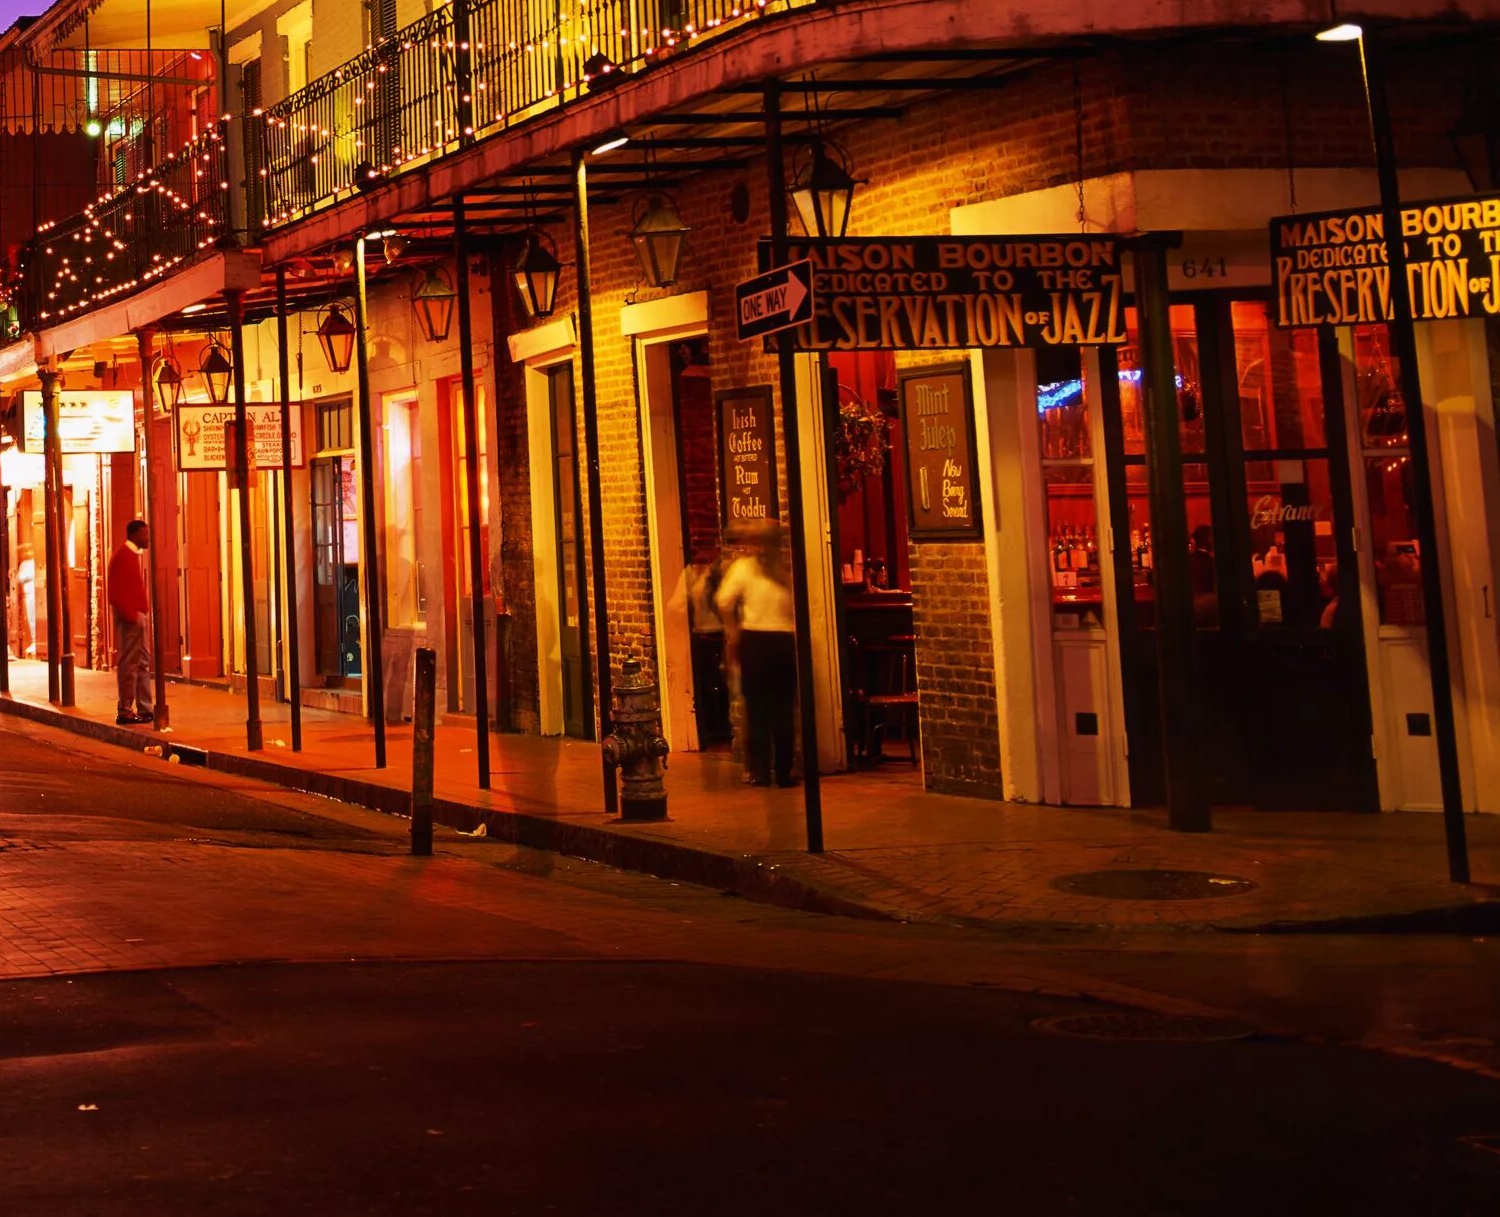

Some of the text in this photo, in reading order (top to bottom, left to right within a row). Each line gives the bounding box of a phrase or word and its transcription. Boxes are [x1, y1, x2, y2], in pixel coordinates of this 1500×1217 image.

[1281, 213, 1384, 248] MAISON
[938, 241, 1115, 269] BOURBON
[1296, 240, 1409, 269] DEDICATE
[1427, 233, 1462, 258] TO
[1182, 256, 1227, 279] 641
[813, 269, 1094, 293] EDICATED TO THE
[1276, 257, 1470, 326] PRESERVTION
[1469, 277, 1491, 294] OF
[743, 286, 787, 321] ONE WAY
[768, 274, 1127, 351] ESERVATION OF JAZZ
[916, 383, 950, 416] Mint
[202, 410, 282, 423] CAPTN AL'
[732, 407, 757, 429] Irish
[728, 431, 762, 453] Coffee
[919, 418, 956, 456] Julep
[734, 465, 759, 485] Rum
[943, 459, 962, 478] Now
[943, 479, 965, 504] Being
[732, 497, 766, 519] Toddy
[943, 497, 969, 518] Served
[1251, 495, 1323, 529] Entrance
